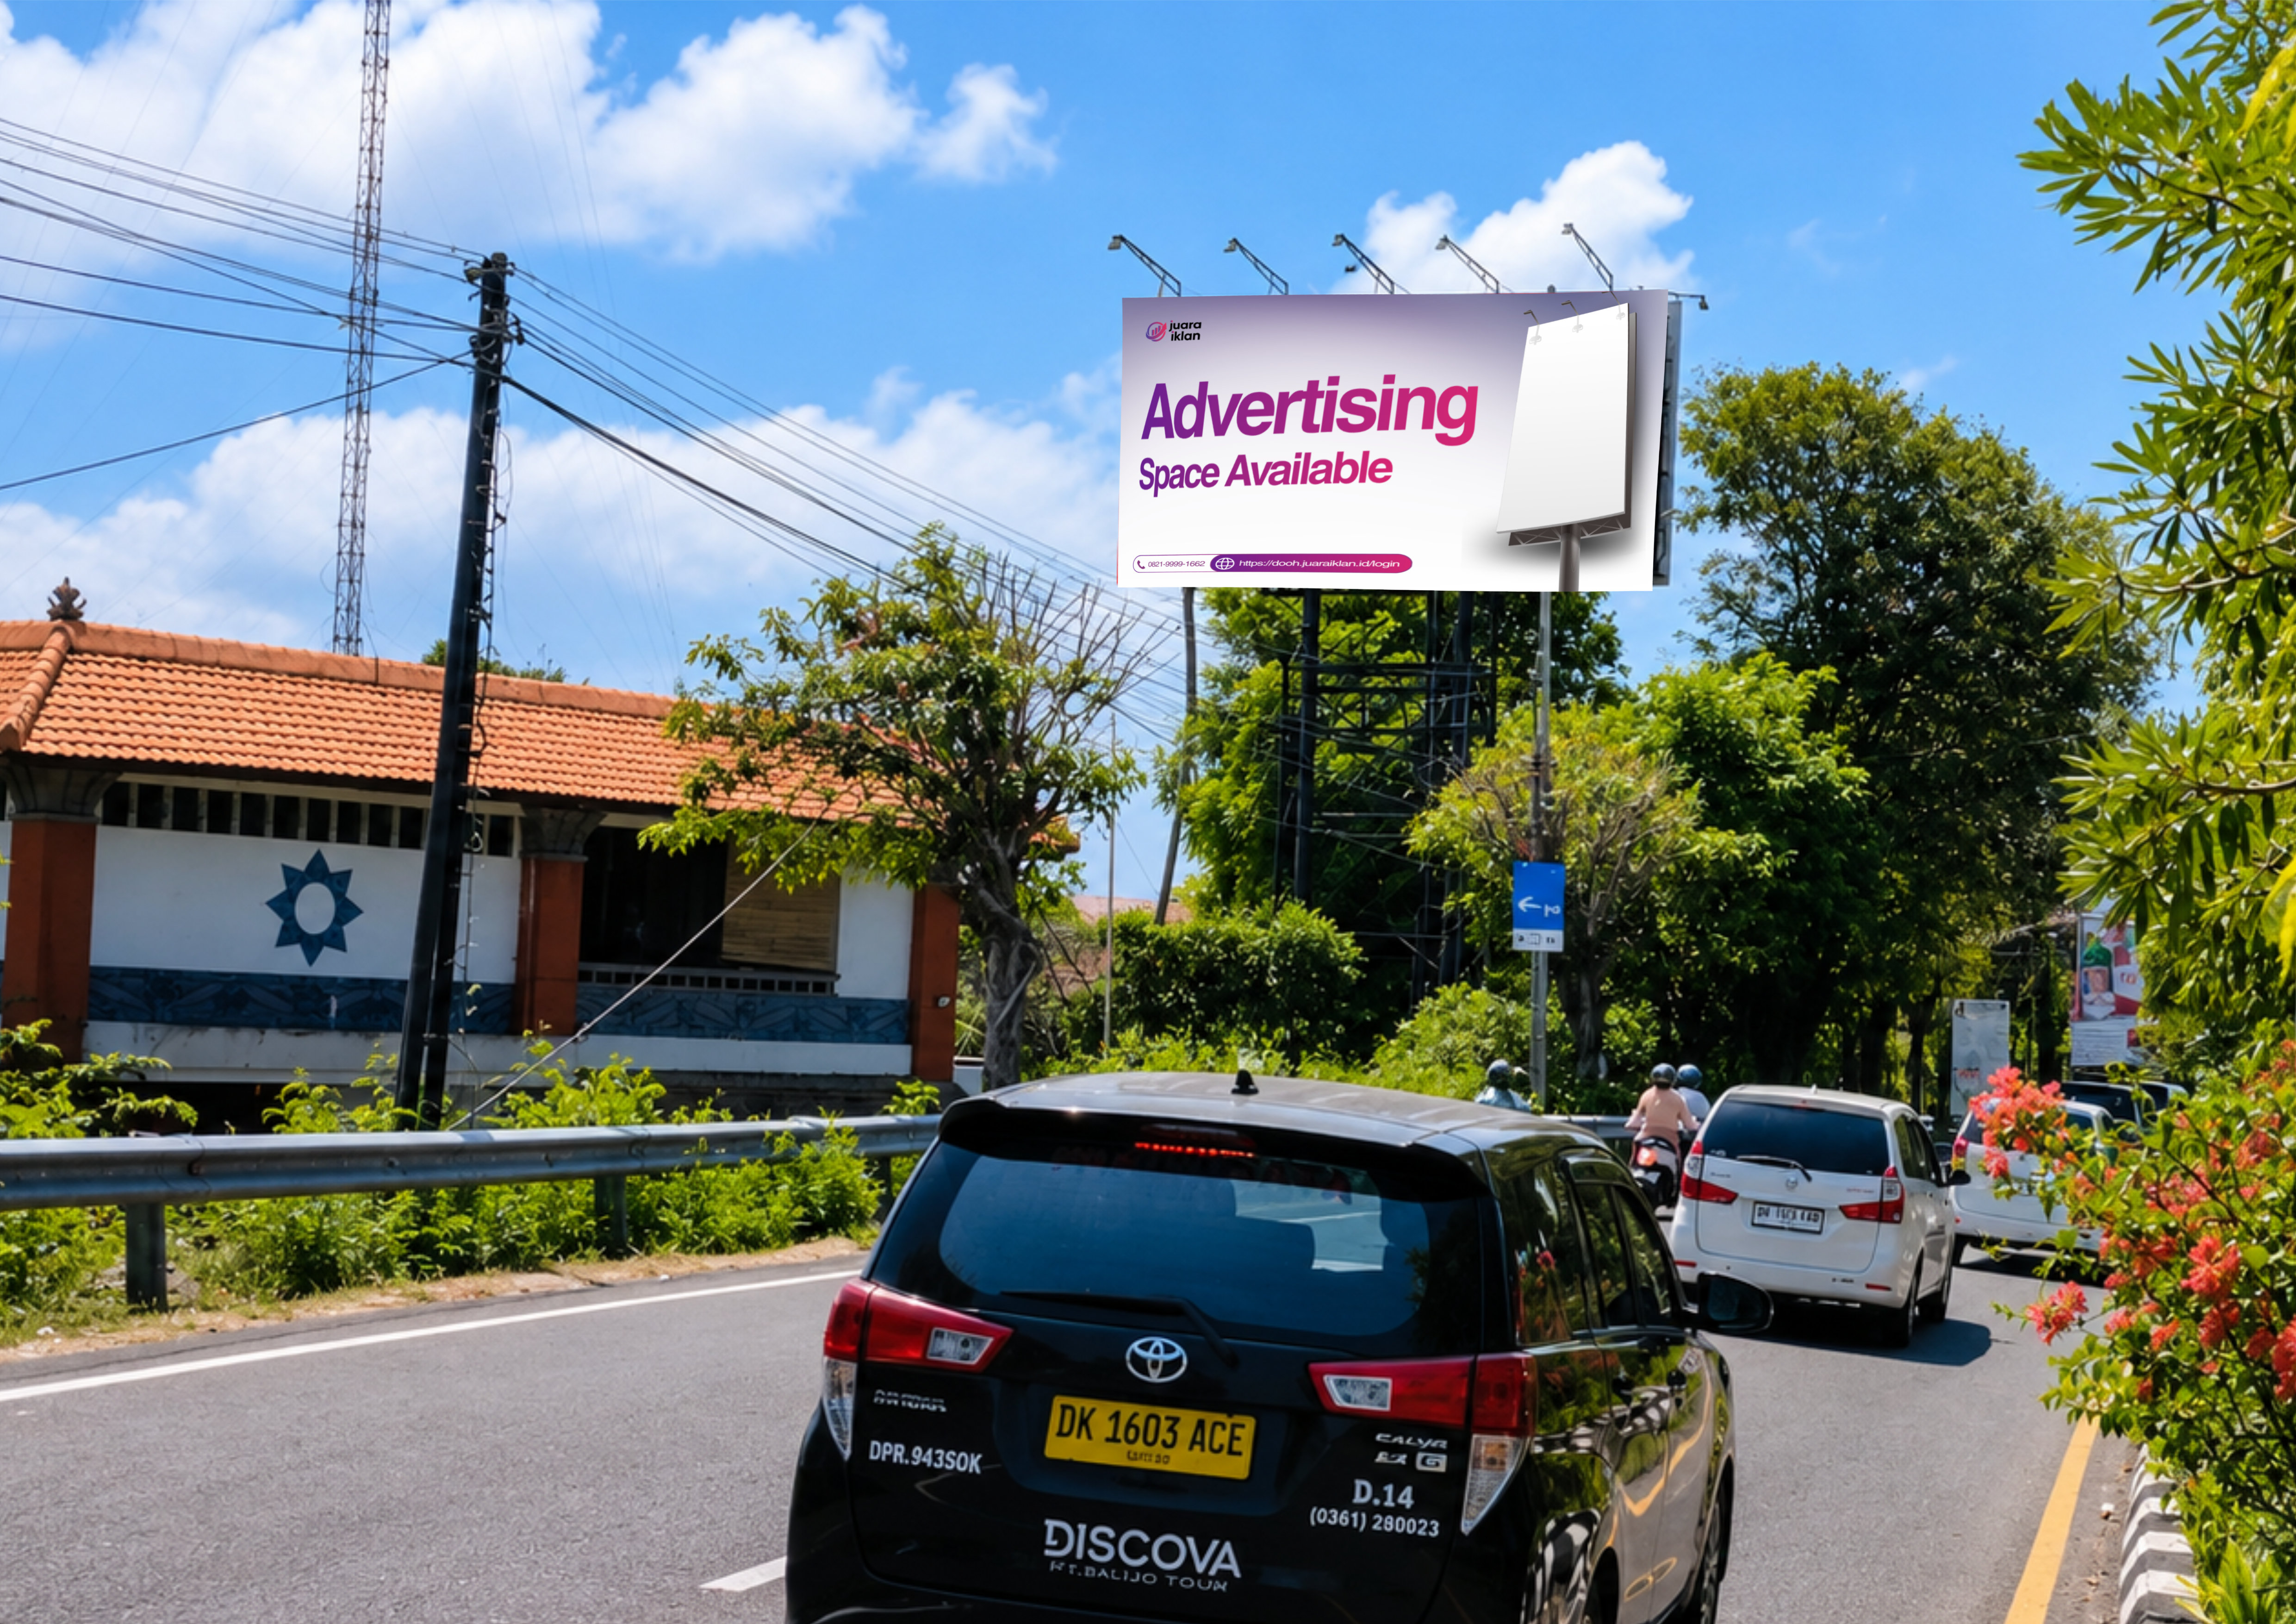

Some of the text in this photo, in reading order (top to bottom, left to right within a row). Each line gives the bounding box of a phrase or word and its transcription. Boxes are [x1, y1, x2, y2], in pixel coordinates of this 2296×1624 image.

[1169, 320, 1201, 332] juara
[1171, 331, 1201, 341] iklan
[1141, 374, 1479, 446] Advertising
[1139, 450, 1393, 498] Space Available
[1239, 560, 1400, 568] https://dooh.juaraiklan.id/login
[1055, 1404, 1246, 1457] DK 1603 ACE
[1352, 1479, 1414, 1509] D.14
[1310, 1506, 1439, 1537] (0361) 280023
[1044, 1518, 1242, 1578] DISCOVA
